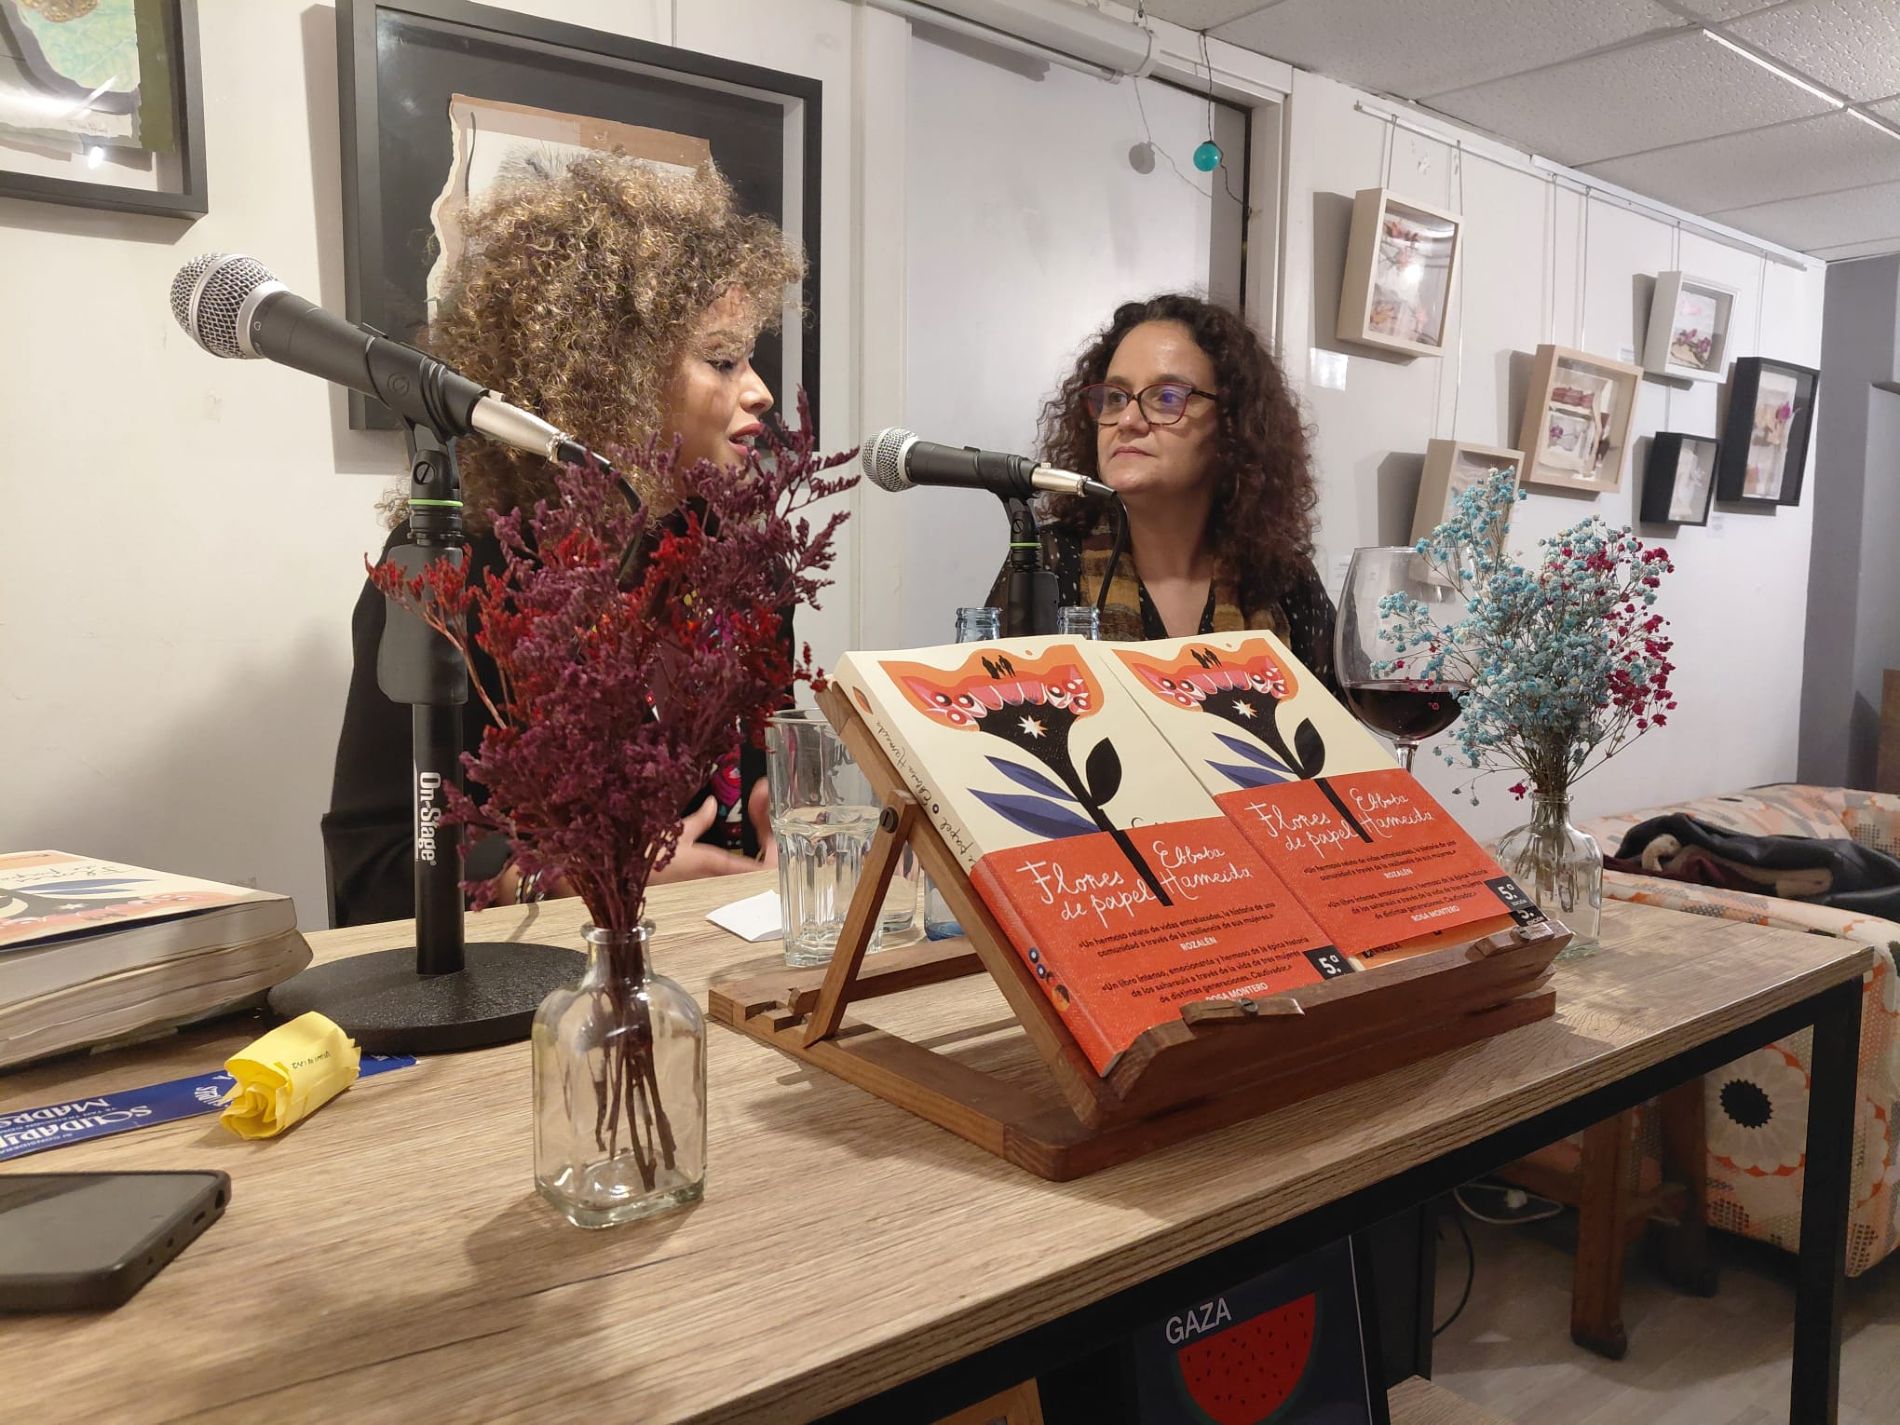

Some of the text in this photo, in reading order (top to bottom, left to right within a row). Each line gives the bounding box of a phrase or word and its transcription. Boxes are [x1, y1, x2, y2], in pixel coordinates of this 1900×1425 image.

[419, 772, 441, 861] On-Stage
[1244, 801, 1331, 838] Flores
[1359, 807, 1434, 839] Hameida
[1153, 840, 1225, 869] Ebbaba
[1286, 819, 1359, 859] de papel
[1016, 861, 1124, 904] Flores
[1159, 862, 1253, 900] Hameida
[1061, 878, 1157, 929] de papel
[1165, 1297, 1232, 1344] GAZA
